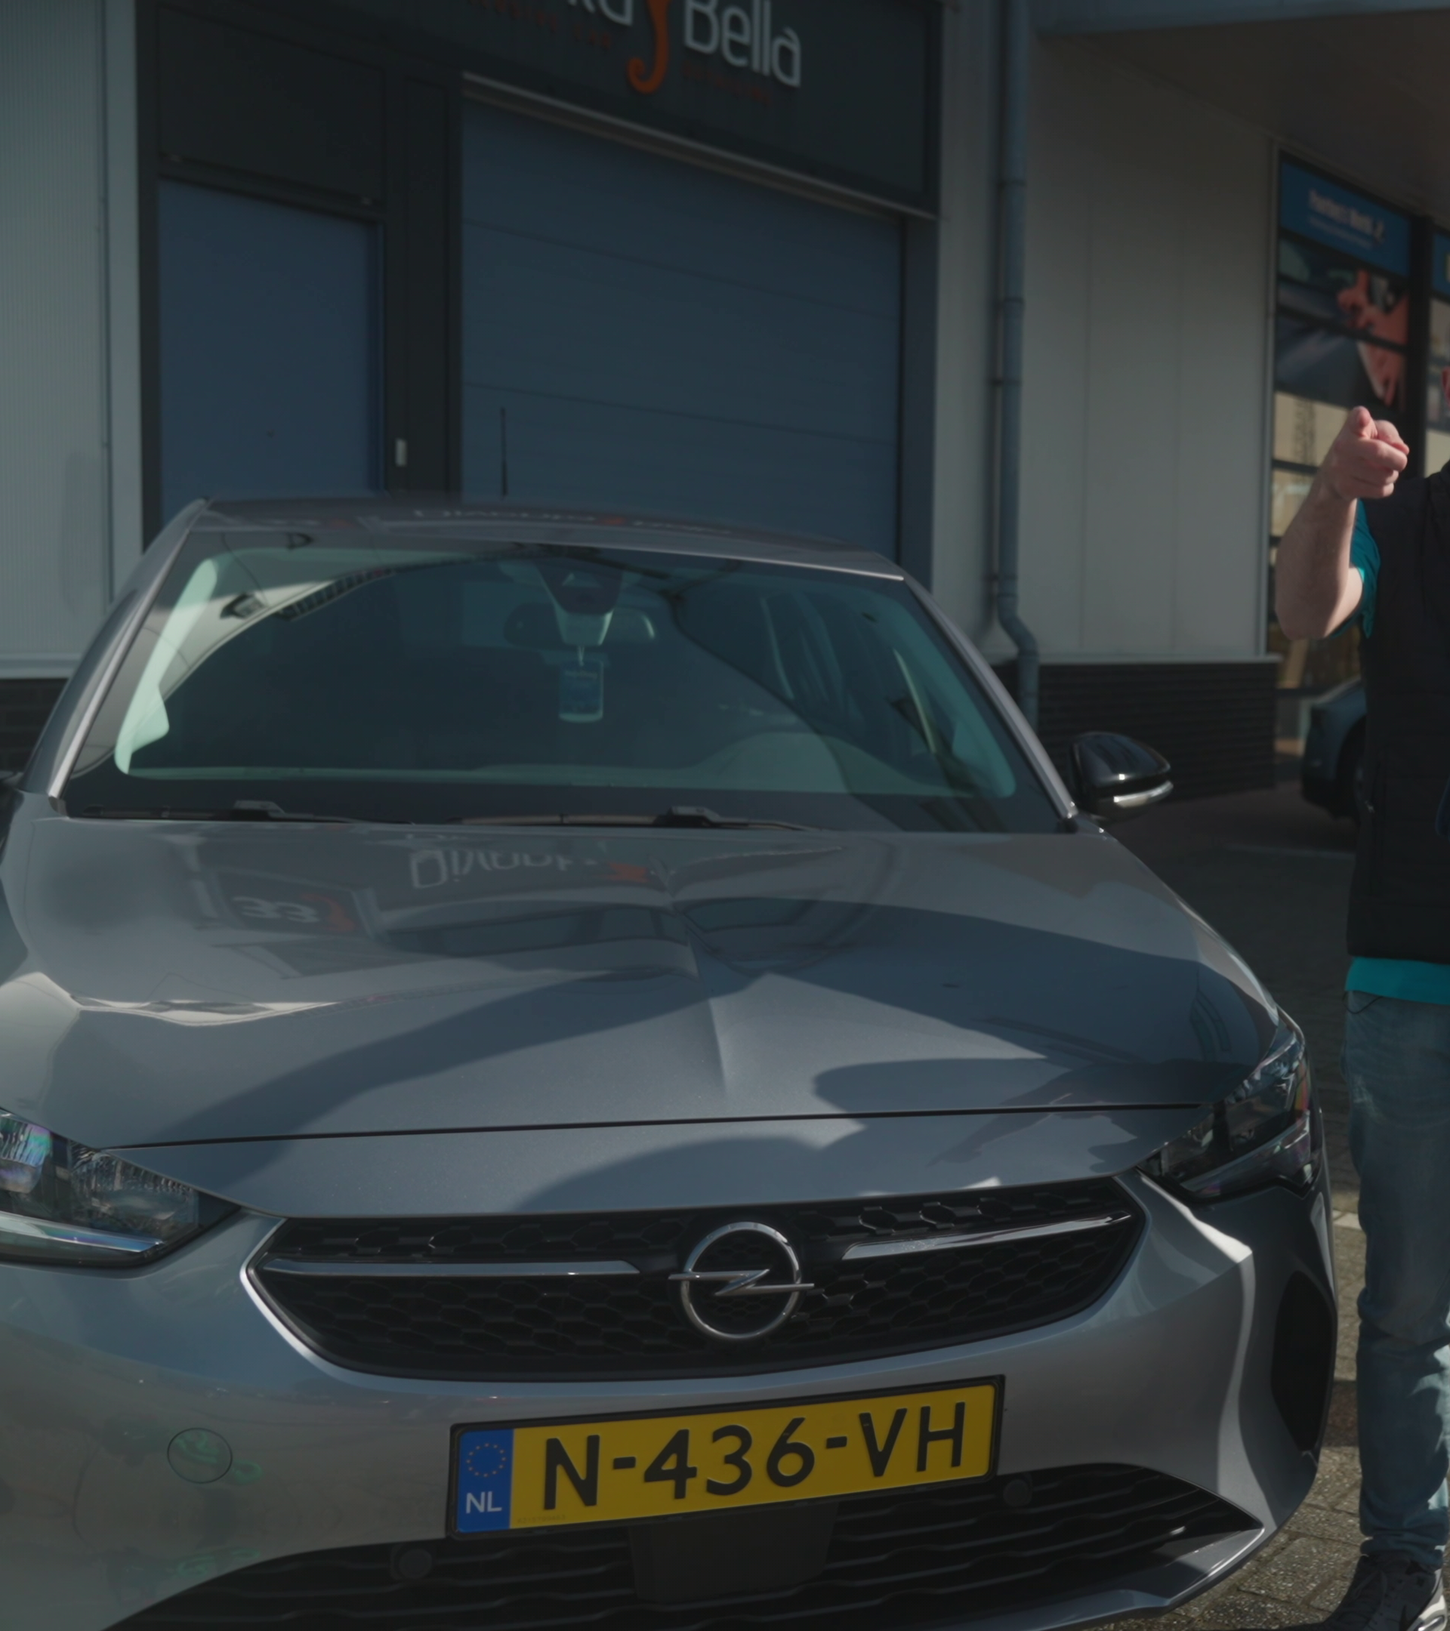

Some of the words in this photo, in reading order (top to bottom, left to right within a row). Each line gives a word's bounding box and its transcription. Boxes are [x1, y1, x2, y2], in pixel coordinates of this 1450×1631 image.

[684, 0, 801, 87] Bella
[543, 1401, 966, 1510] N-436-VH
[465, 1491, 503, 1514] NL
